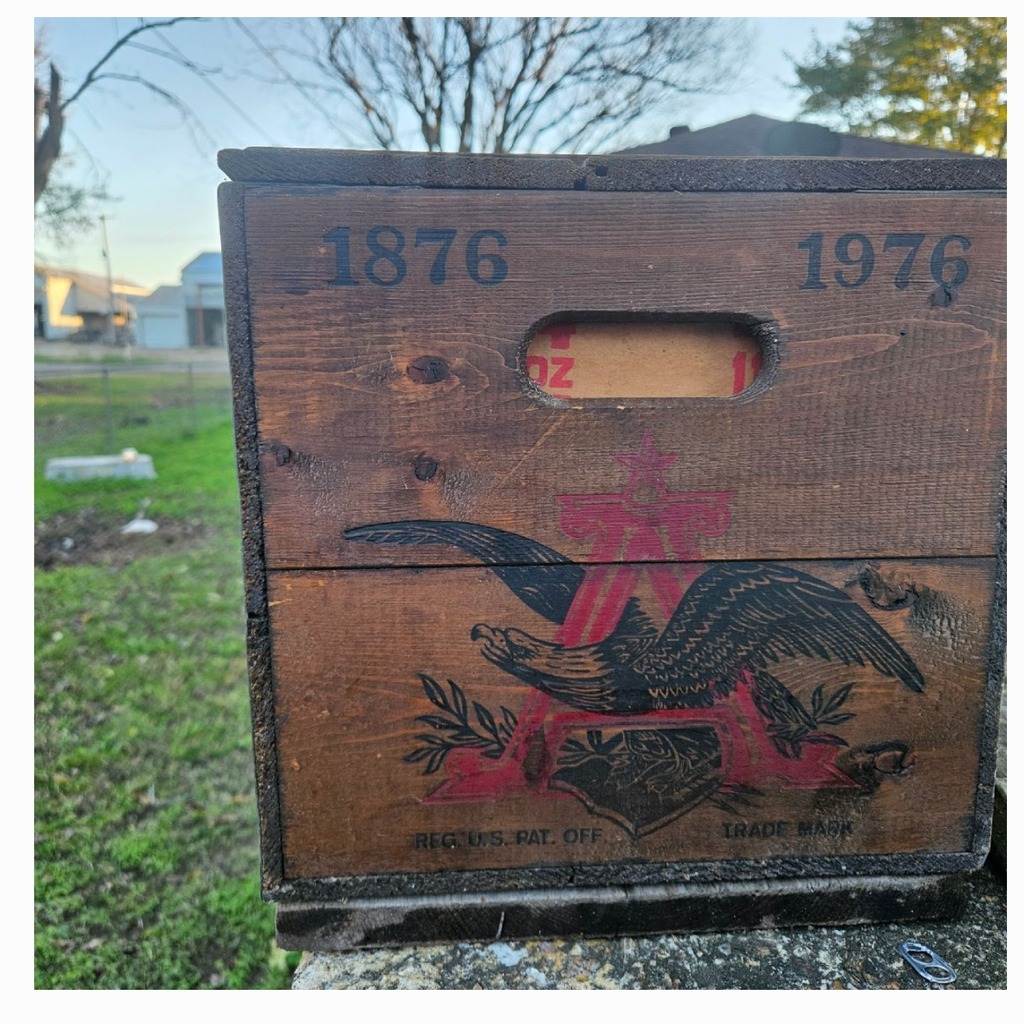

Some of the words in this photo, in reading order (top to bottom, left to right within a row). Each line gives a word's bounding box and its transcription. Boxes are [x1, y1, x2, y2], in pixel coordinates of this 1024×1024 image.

[322, 225, 509, 287] 1876
[797, 232, 972, 291] 1976
[722, 821, 786, 839] TRADE
[802, 819, 853, 837] MARK
